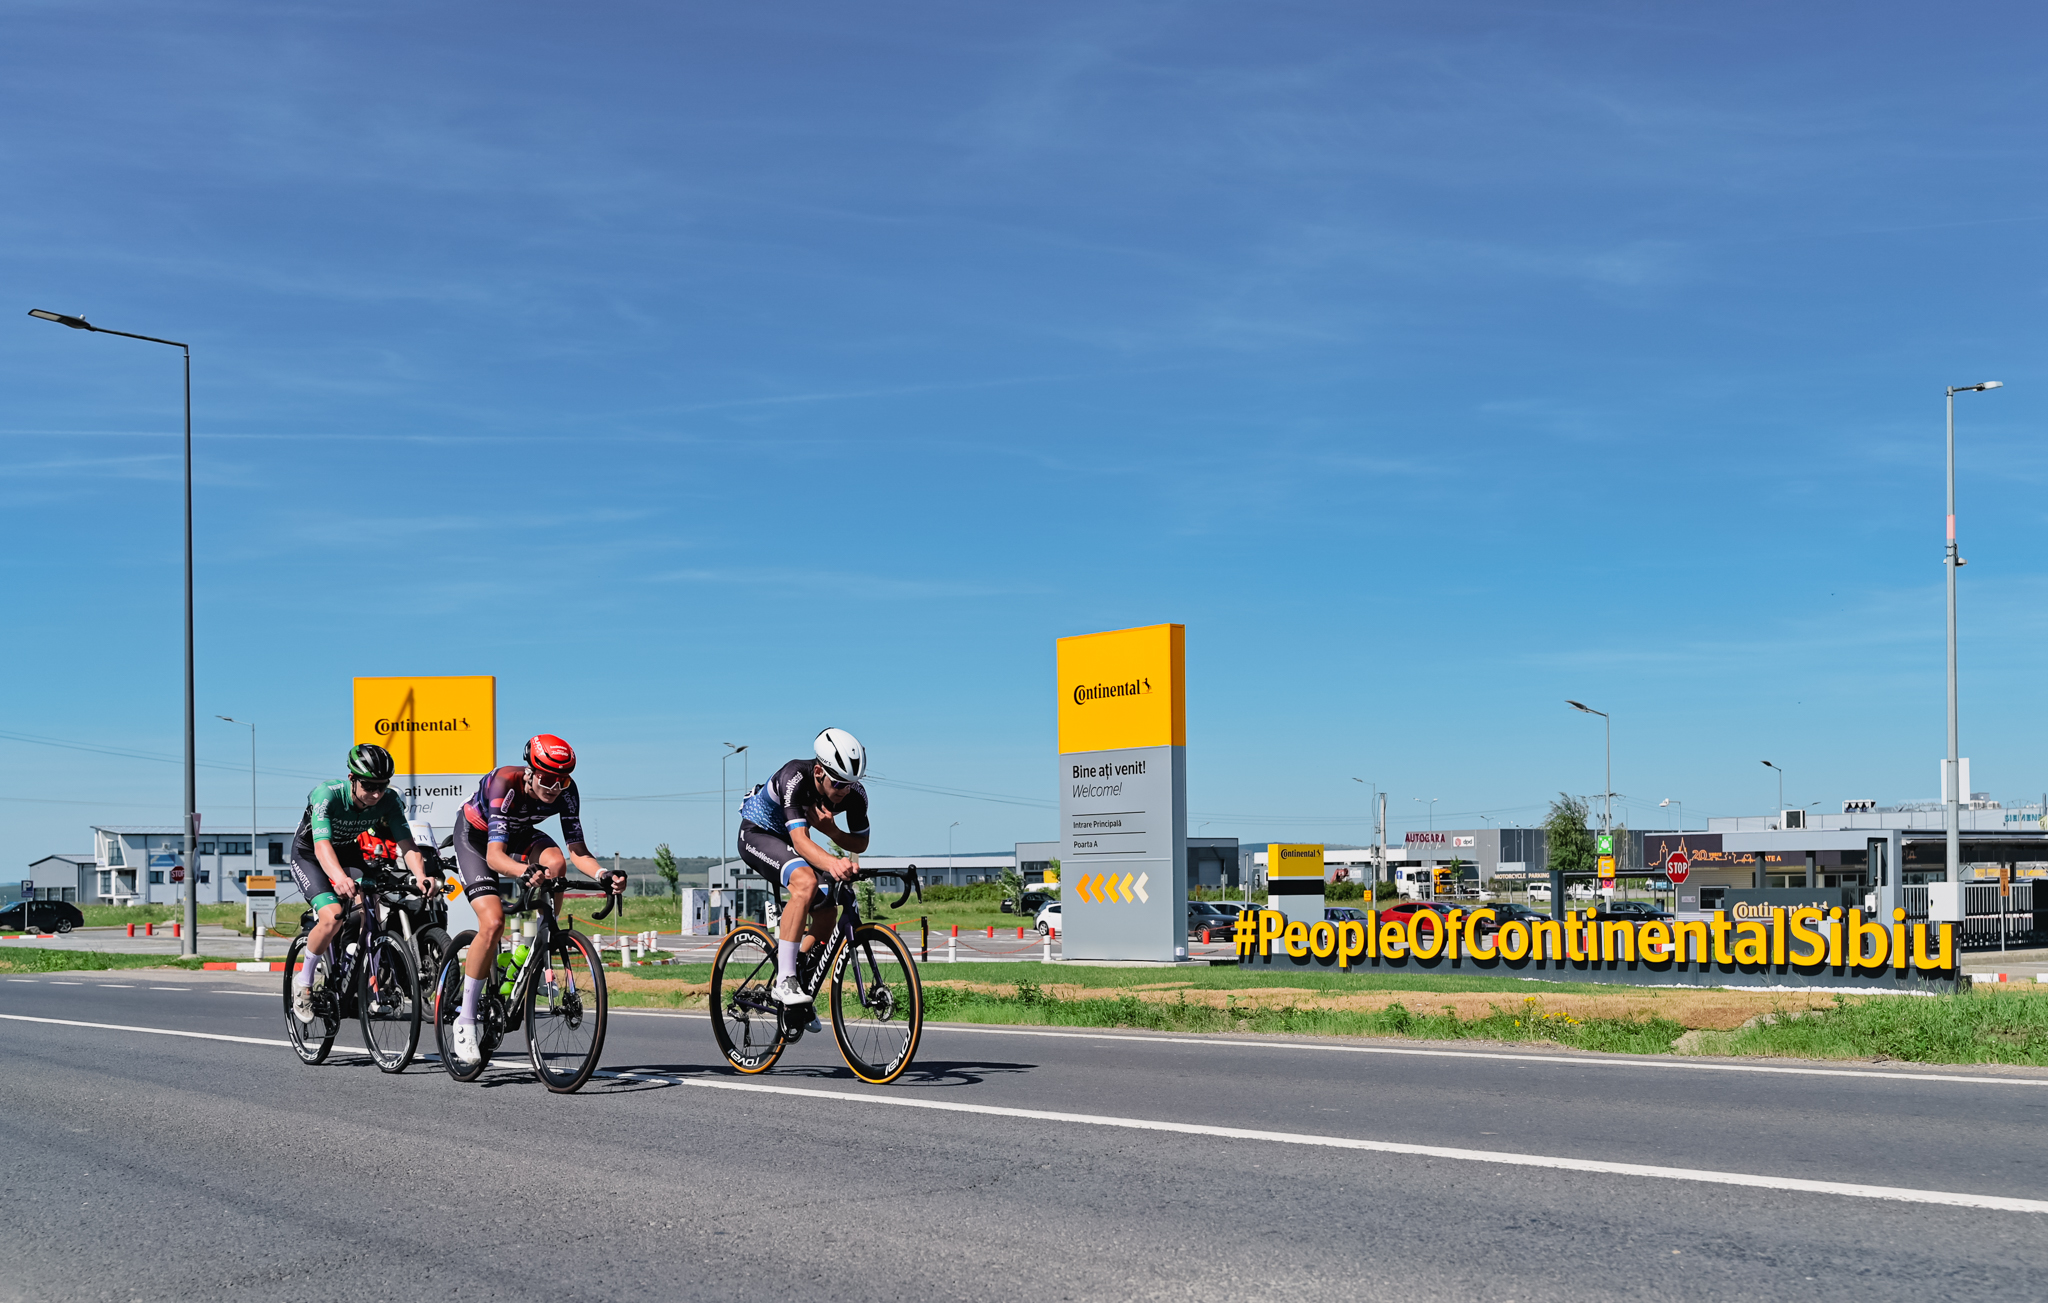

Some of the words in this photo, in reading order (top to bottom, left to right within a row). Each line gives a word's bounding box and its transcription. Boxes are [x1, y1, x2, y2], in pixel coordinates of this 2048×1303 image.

[1073, 679, 1140, 706] Continental
[374, 718, 457, 736] Continental
[1072, 764, 1097, 779] Bine
[1098, 763, 1113, 781] ați
[1114, 760, 1147, 776] venit!
[404, 785, 421, 800] ați
[424, 784, 463, 797] venit!
[1072, 781, 1123, 799] Welcome!
[403, 801, 434, 814] ome!
[1073, 819, 1092, 829] Intrare
[1073, 840, 1093, 849] Poarta
[1093, 839, 1099, 848] A
[1405, 833, 1446, 843] AUTOGARA
[1463, 838, 1473, 846] dpd
[745, 842, 781, 870] VolkerWessels
[1280, 848, 1317, 860] Continental
[291, 859, 311, 891] PARKHOTEL
[1668, 861, 1688, 875] STOP
[23, 881, 32, 891] P
[733, 932, 767, 949] roval
[1233, 907, 1954, 970] #PeopleOfContinentalSibiu
[833, 942, 851, 984] rova
[727, 1048, 760, 1067] roval
[884, 1027, 912, 1076] roval
